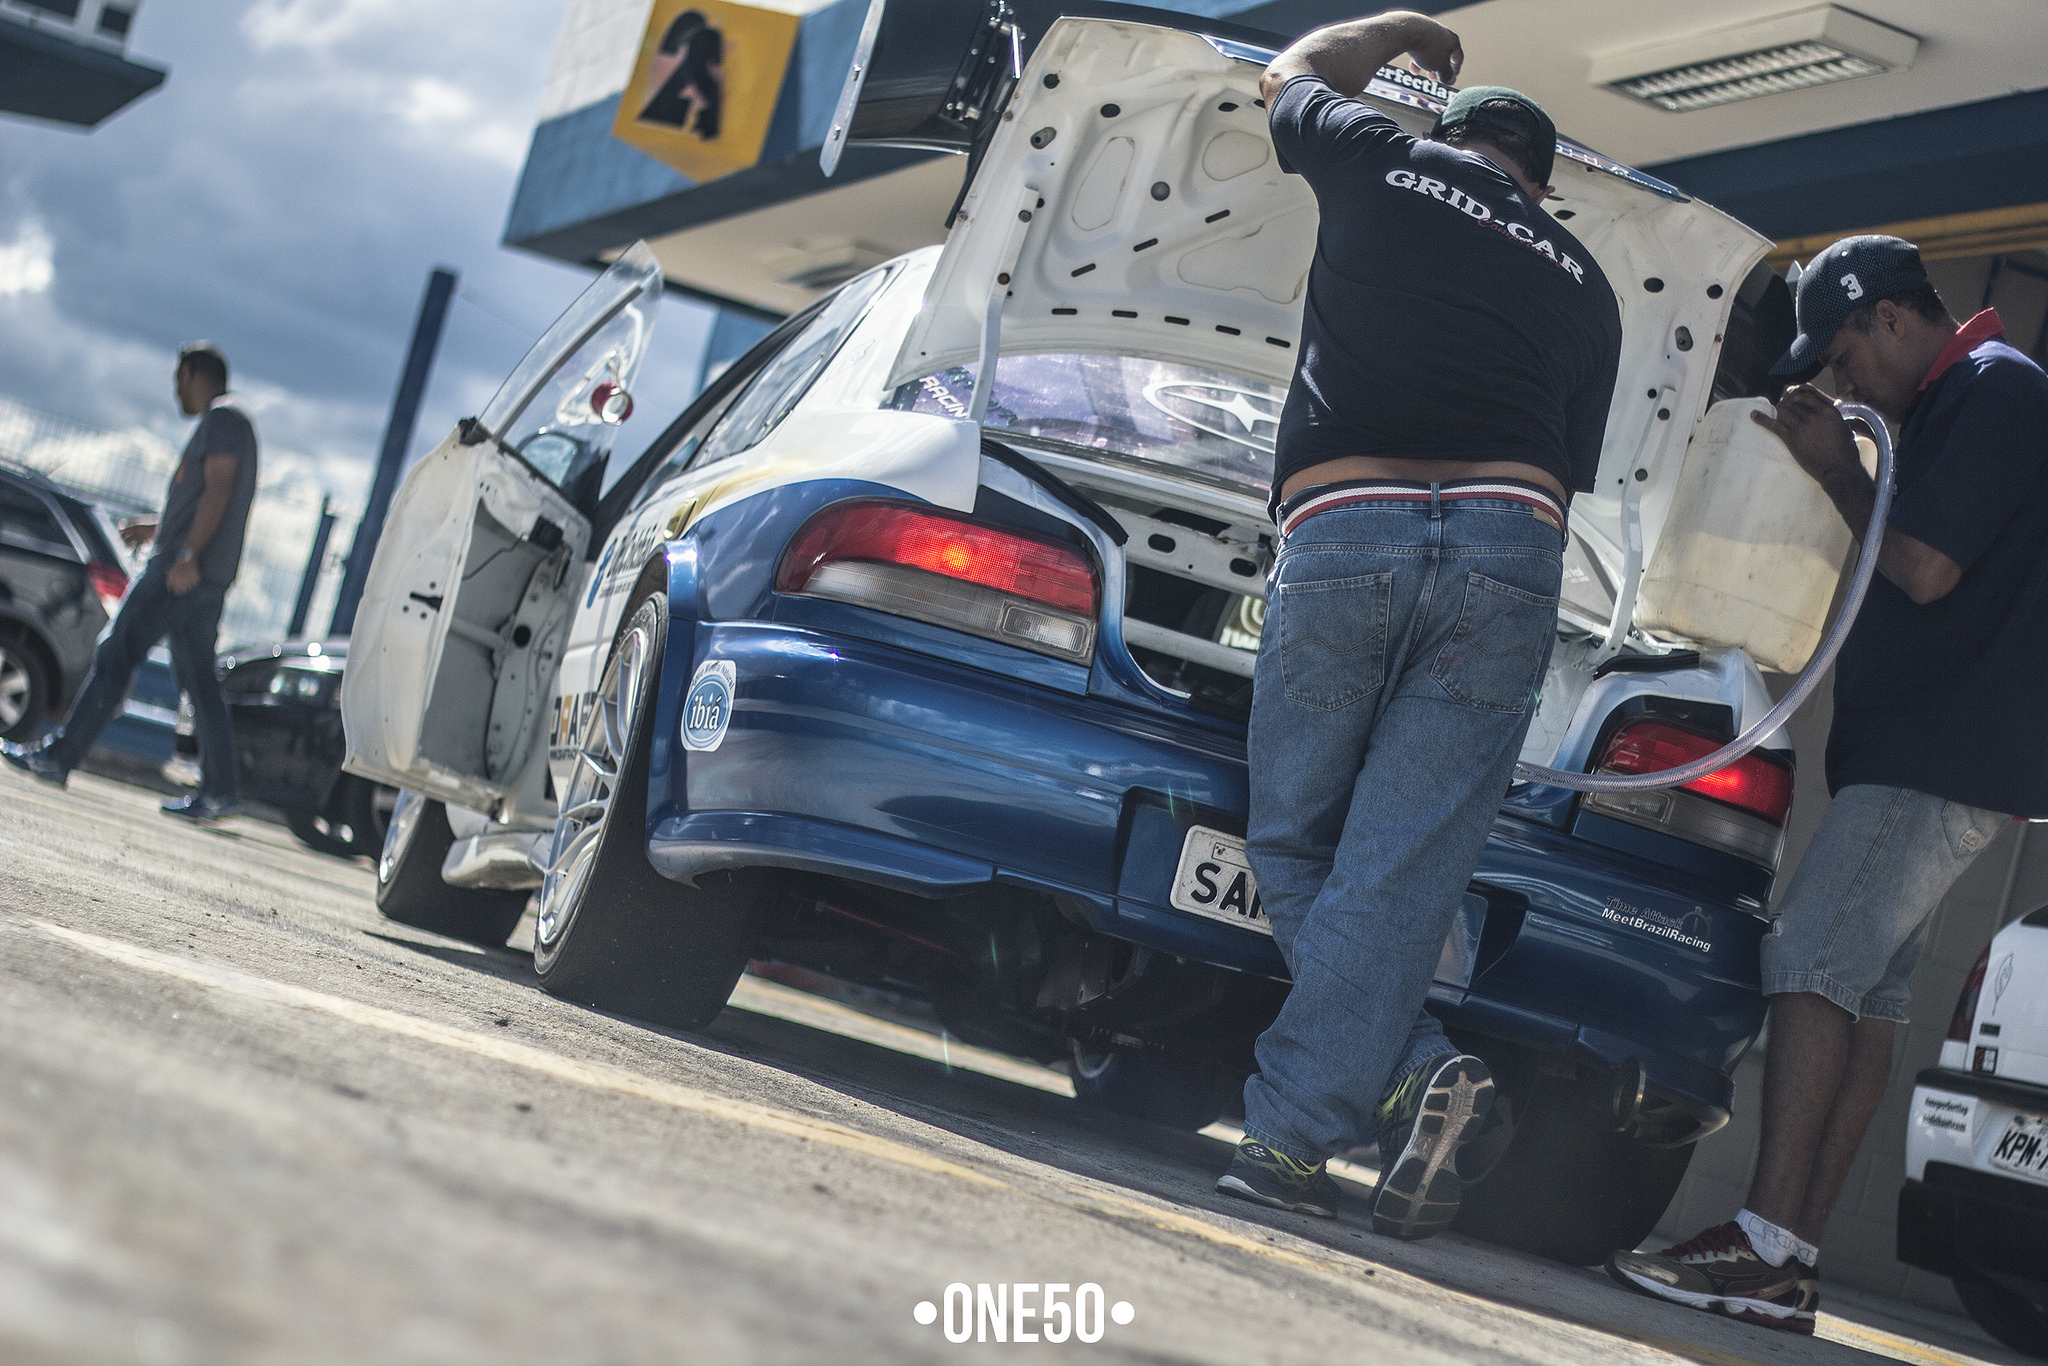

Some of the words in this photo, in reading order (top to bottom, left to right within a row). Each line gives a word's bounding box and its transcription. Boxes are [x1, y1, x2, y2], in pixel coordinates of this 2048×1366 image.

[1385, 169, 1584, 285] GRID-CAR
[1841, 273, 1863, 300] 3
[689, 693, 723, 731] ibiá
[1602, 907, 1711, 953] MeetBrazilRacing
[1607, 896, 1638, 915] Time
[1641, 907, 1684, 929] Attack
